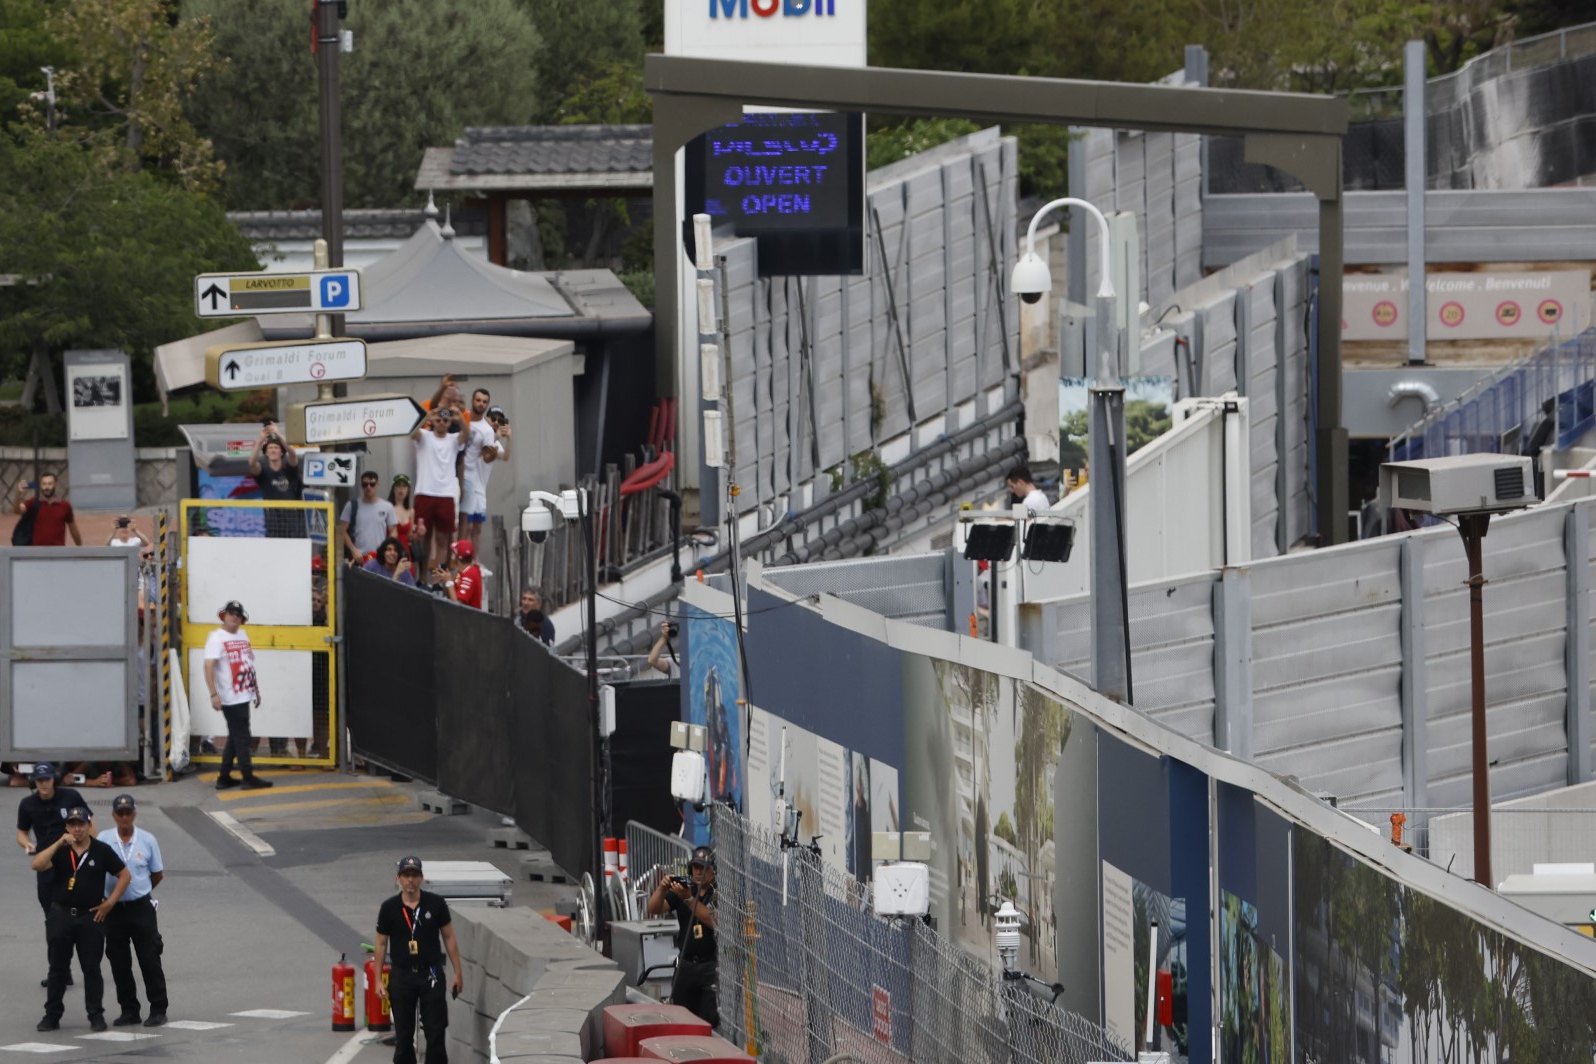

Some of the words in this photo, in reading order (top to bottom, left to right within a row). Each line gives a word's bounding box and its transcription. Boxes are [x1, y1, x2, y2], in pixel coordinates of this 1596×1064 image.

[724, 165, 828, 186] OUVERT
[741, 194, 810, 214] OPEN
[245, 278, 295, 290] LARVOTTO
[327, 280, 342, 303] P
[244, 352, 301, 367] Grimaldi
[307, 349, 347, 362] Forum
[310, 405, 357, 424] Grimaldi
[362, 405, 394, 419] Forum
